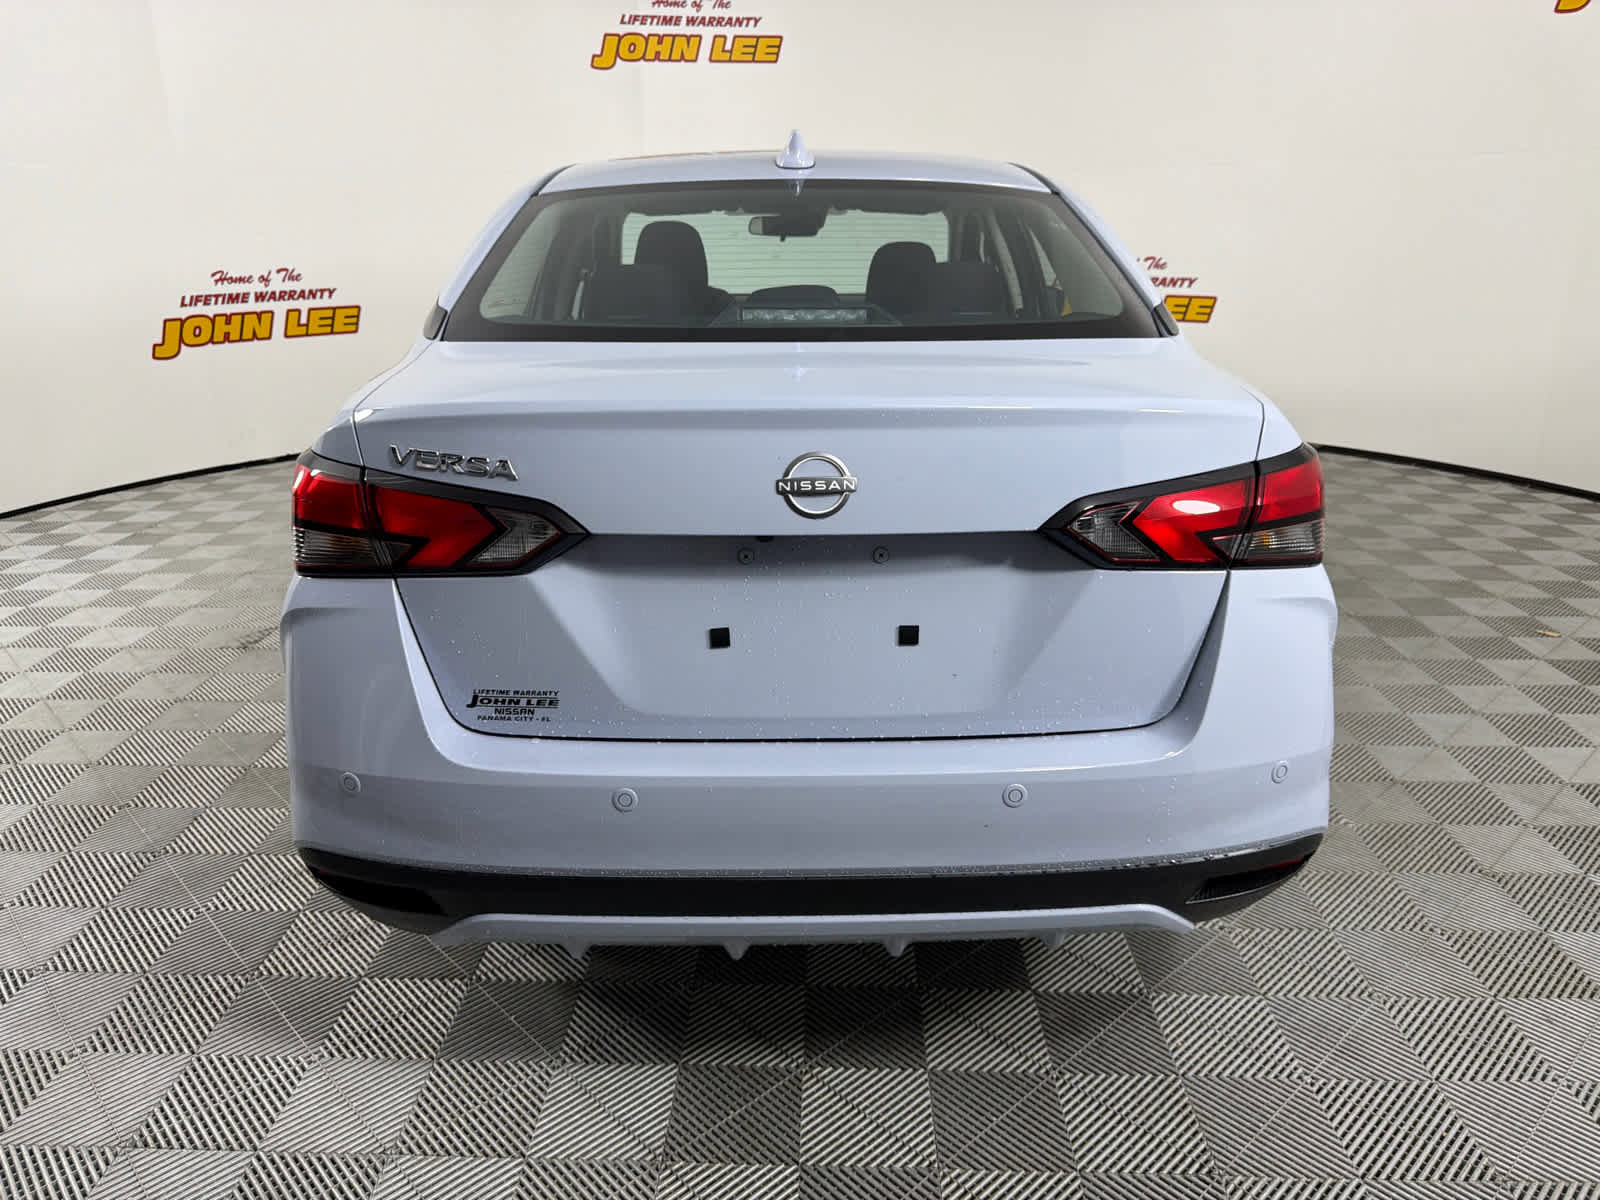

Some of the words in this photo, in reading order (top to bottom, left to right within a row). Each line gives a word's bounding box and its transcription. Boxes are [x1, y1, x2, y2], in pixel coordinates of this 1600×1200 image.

[620, 14, 683, 26] LIFETIME
[685, 16, 761, 27] WARRANTY
[591, 32, 702, 70] JOHN
[709, 34, 783, 63] LEE
[1143, 256, 1167, 270] The
[211, 270, 254, 286] Home
[258, 270, 272, 287] of
[276, 268, 302, 283] The
[180, 291, 250, 307] LIFETIME
[254, 288, 336, 303] WARRANTY
[152, 310, 274, 360] JOHN
[284, 305, 361, 338] LEE
[389, 444, 519, 481] VERSA
[778, 480, 855, 491] NISSAN
[466, 694, 520, 708] JOHN
